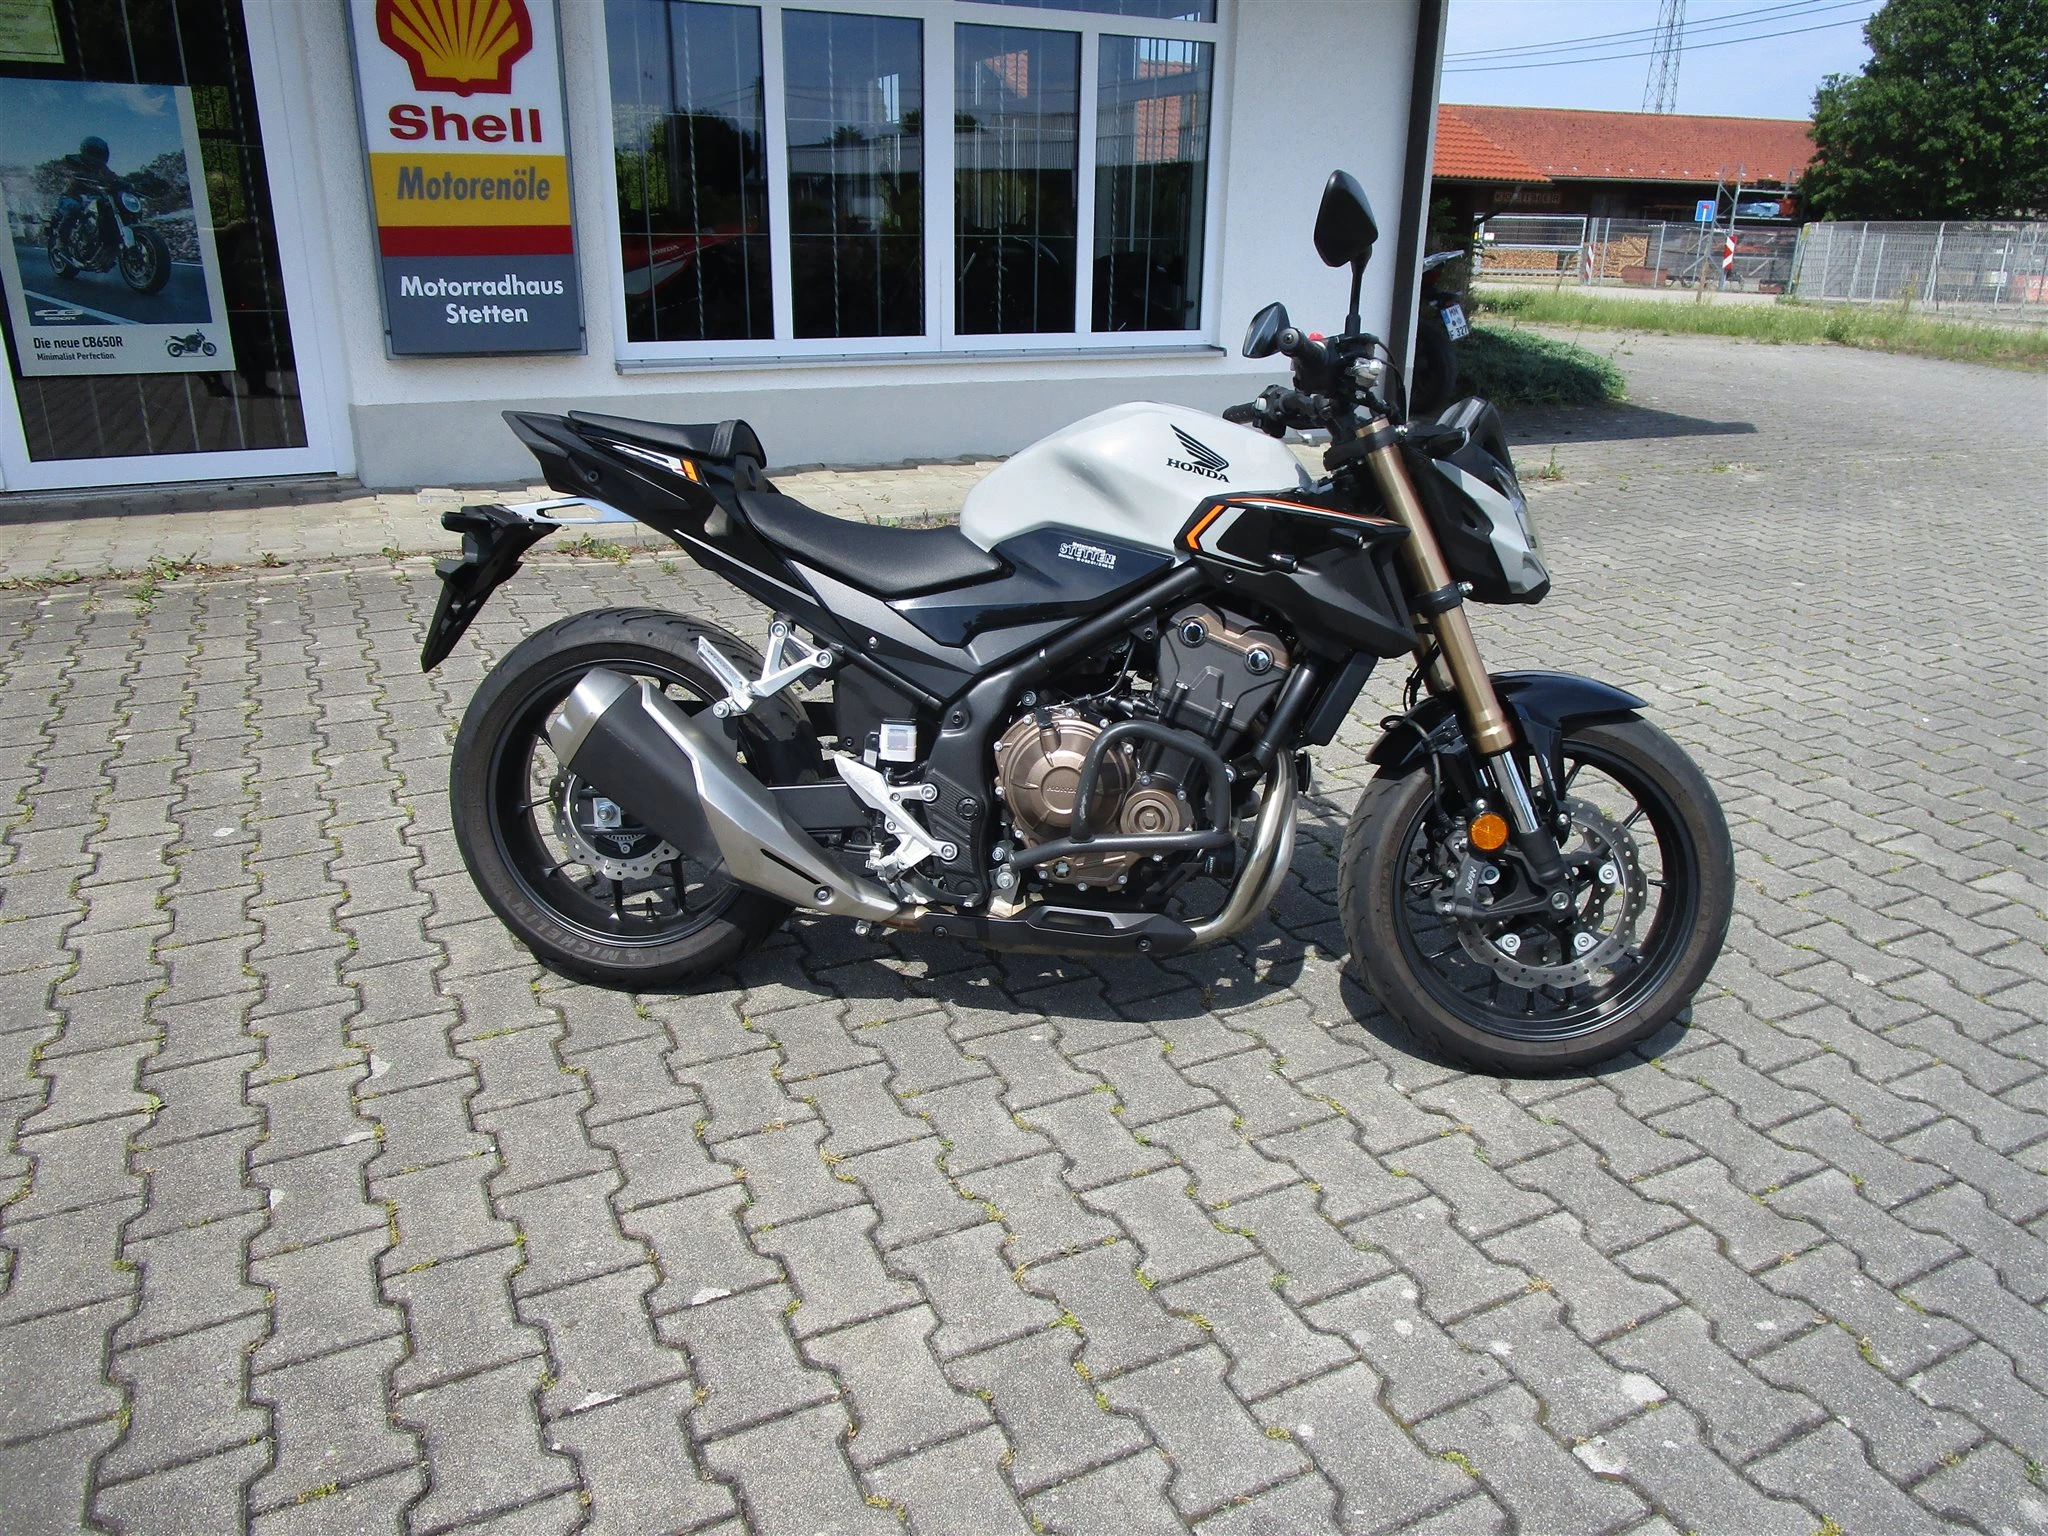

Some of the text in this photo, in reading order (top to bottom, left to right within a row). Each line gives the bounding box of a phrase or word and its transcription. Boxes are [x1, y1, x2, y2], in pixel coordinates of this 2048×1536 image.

[388, 104, 543, 143] Shell
[397, 166, 550, 201] Motorenöle
[401, 274, 564, 297] Motorradhaus
[446, 303, 529, 324] Stetten
[33, 336, 123, 349] Die neue CB650R
[37, 352, 116, 361] Minimalist Perfection.
[1166, 458, 1230, 483] HONDA
[1059, 542, 1113, 565] STETTEN
[514, 901, 620, 962] MICHELIN
